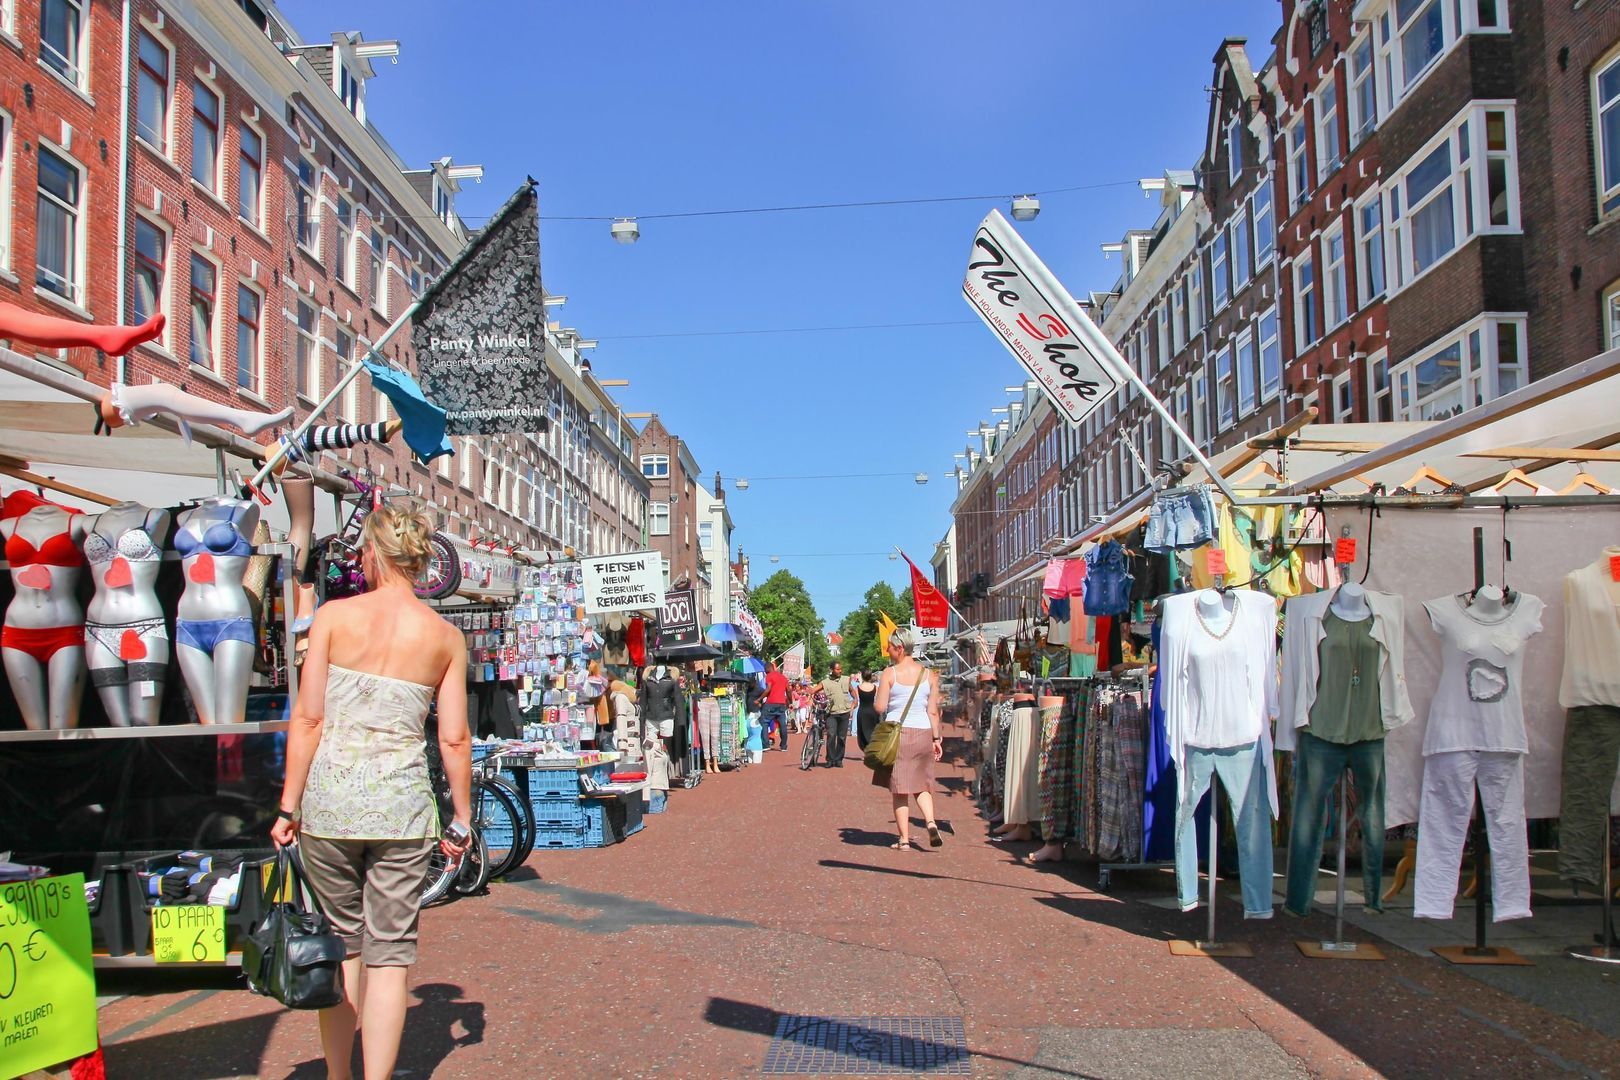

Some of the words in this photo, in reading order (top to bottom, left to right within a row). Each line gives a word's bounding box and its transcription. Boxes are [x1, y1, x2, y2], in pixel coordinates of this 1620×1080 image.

[968, 237, 1020, 307] The
[1016, 312, 1100, 402] Shop
[430, 337, 474, 353] Panty
[478, 333, 530, 349] Winkel
[433, 357, 469, 369] Lingerie
[471, 356, 479, 366] &
[481, 355, 531, 366] beenmode
[979, 299, 1015, 339] HOLLANDSE
[1012, 338, 1034, 362] MATEN
[1043, 374, 1054, 386] 38
[1065, 399, 1075, 411] 46
[446, 405, 544, 421] w.pantywinkel.nl
[593, 559, 646, 574] FIETSEN
[600, 584, 646, 595] GEBRUIKT
[602, 575, 631, 585] NIEUW
[596, 592, 657, 608] REPARATIES
[662, 601, 691, 624] DOCI
[0, 881, 71, 927] gging's
[153, 908, 171, 929] 10
[177, 905, 215, 929] PAAR
[22, 929, 47, 961] €
[159, 936, 174, 945] PAAR
[191, 928, 208, 962] 6
[14, 1002, 53, 1029] KLEUREN
